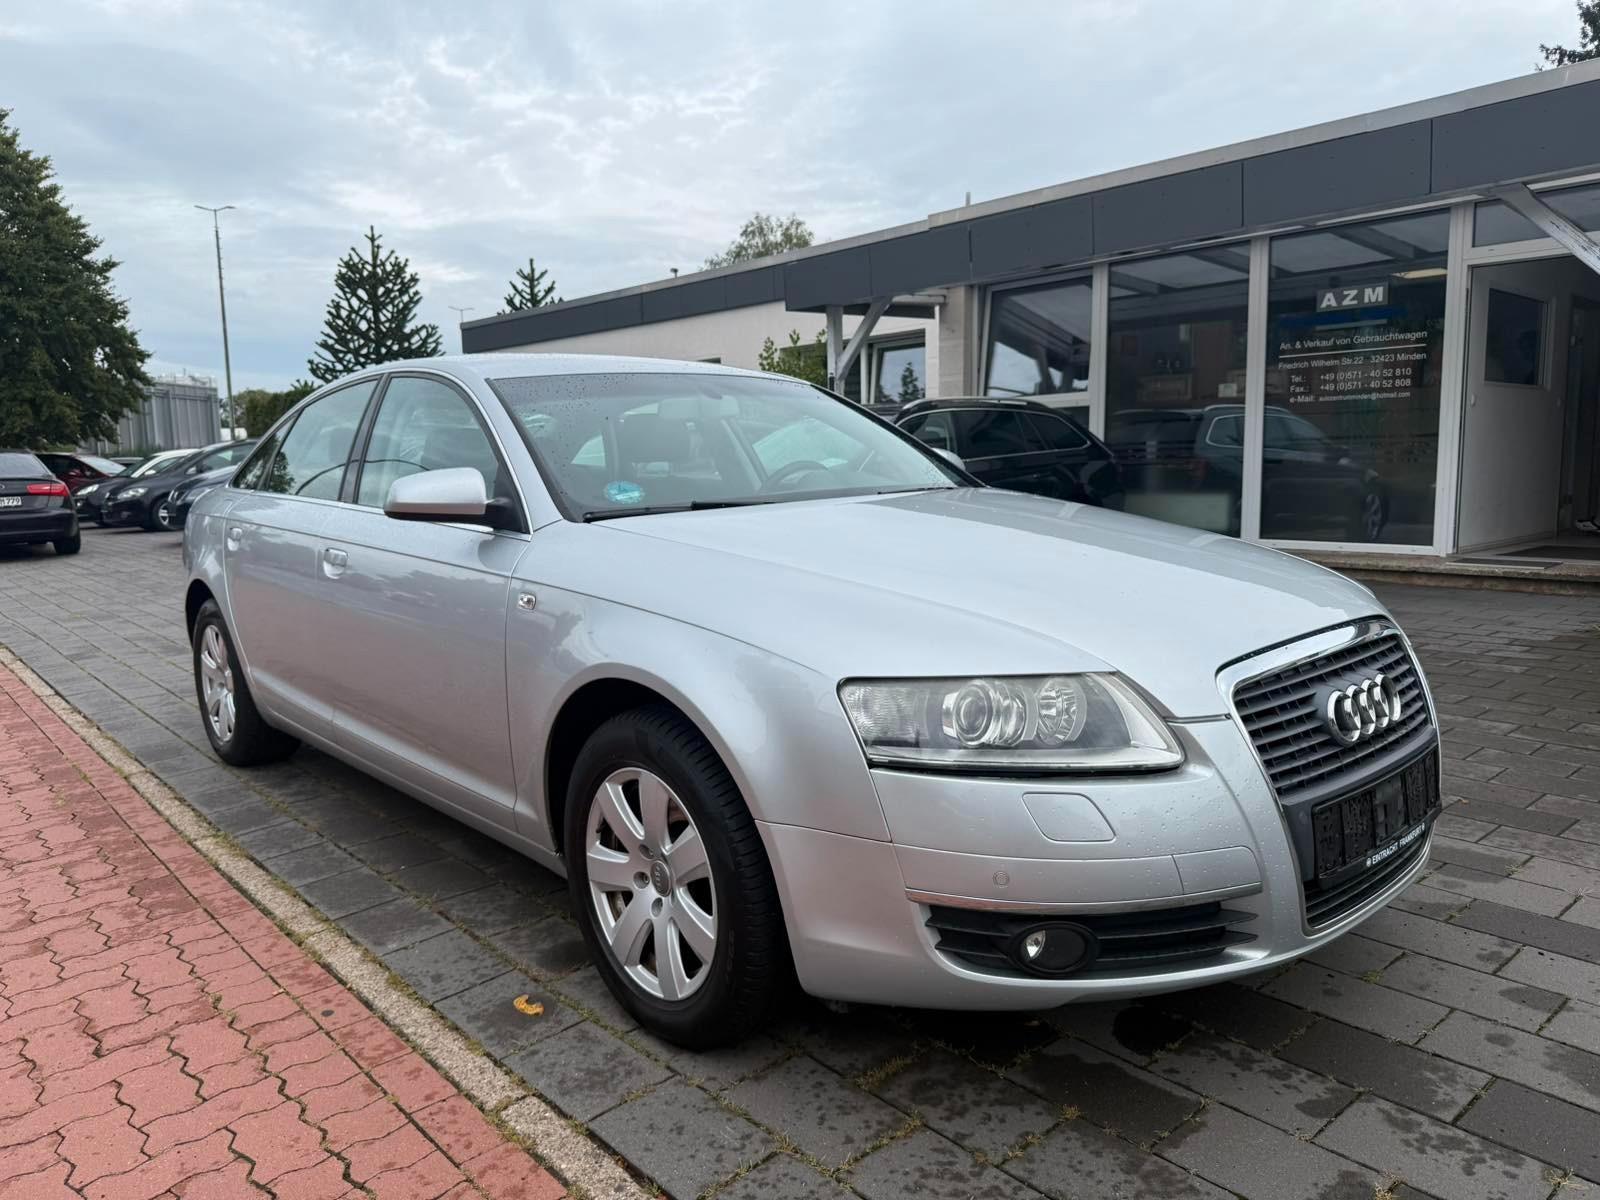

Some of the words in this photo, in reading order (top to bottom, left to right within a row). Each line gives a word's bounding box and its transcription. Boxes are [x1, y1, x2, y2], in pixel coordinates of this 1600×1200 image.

[1294, 340, 1302, 349] &
[1302, 337, 1334, 348] Verkauf
[1335, 337, 1351, 345] von
[1353, 331, 1428, 344] Gebrauchtwagen
[1278, 360, 1309, 370] Friedrich
[1310, 359, 1340, 368] Wilhelm
[1370, 353, 1395, 363] 32423
[1396, 352, 1427, 361] Minden
[1320, 371, 1335, 381] +49
[1336, 370, 1362, 382] (0)571
[1370, 369, 1381, 378] 40
[1382, 368, 1394, 377] 52
[1395, 367, 1412, 376] 810
[1336, 381, 1361, 392] (0)571
[1370, 380, 1381, 388] 40
[1382, 379, 1393, 388] 52
[1394, 378, 1411, 387] 808
[1372, 841, 1398, 865] EINTRACHT
